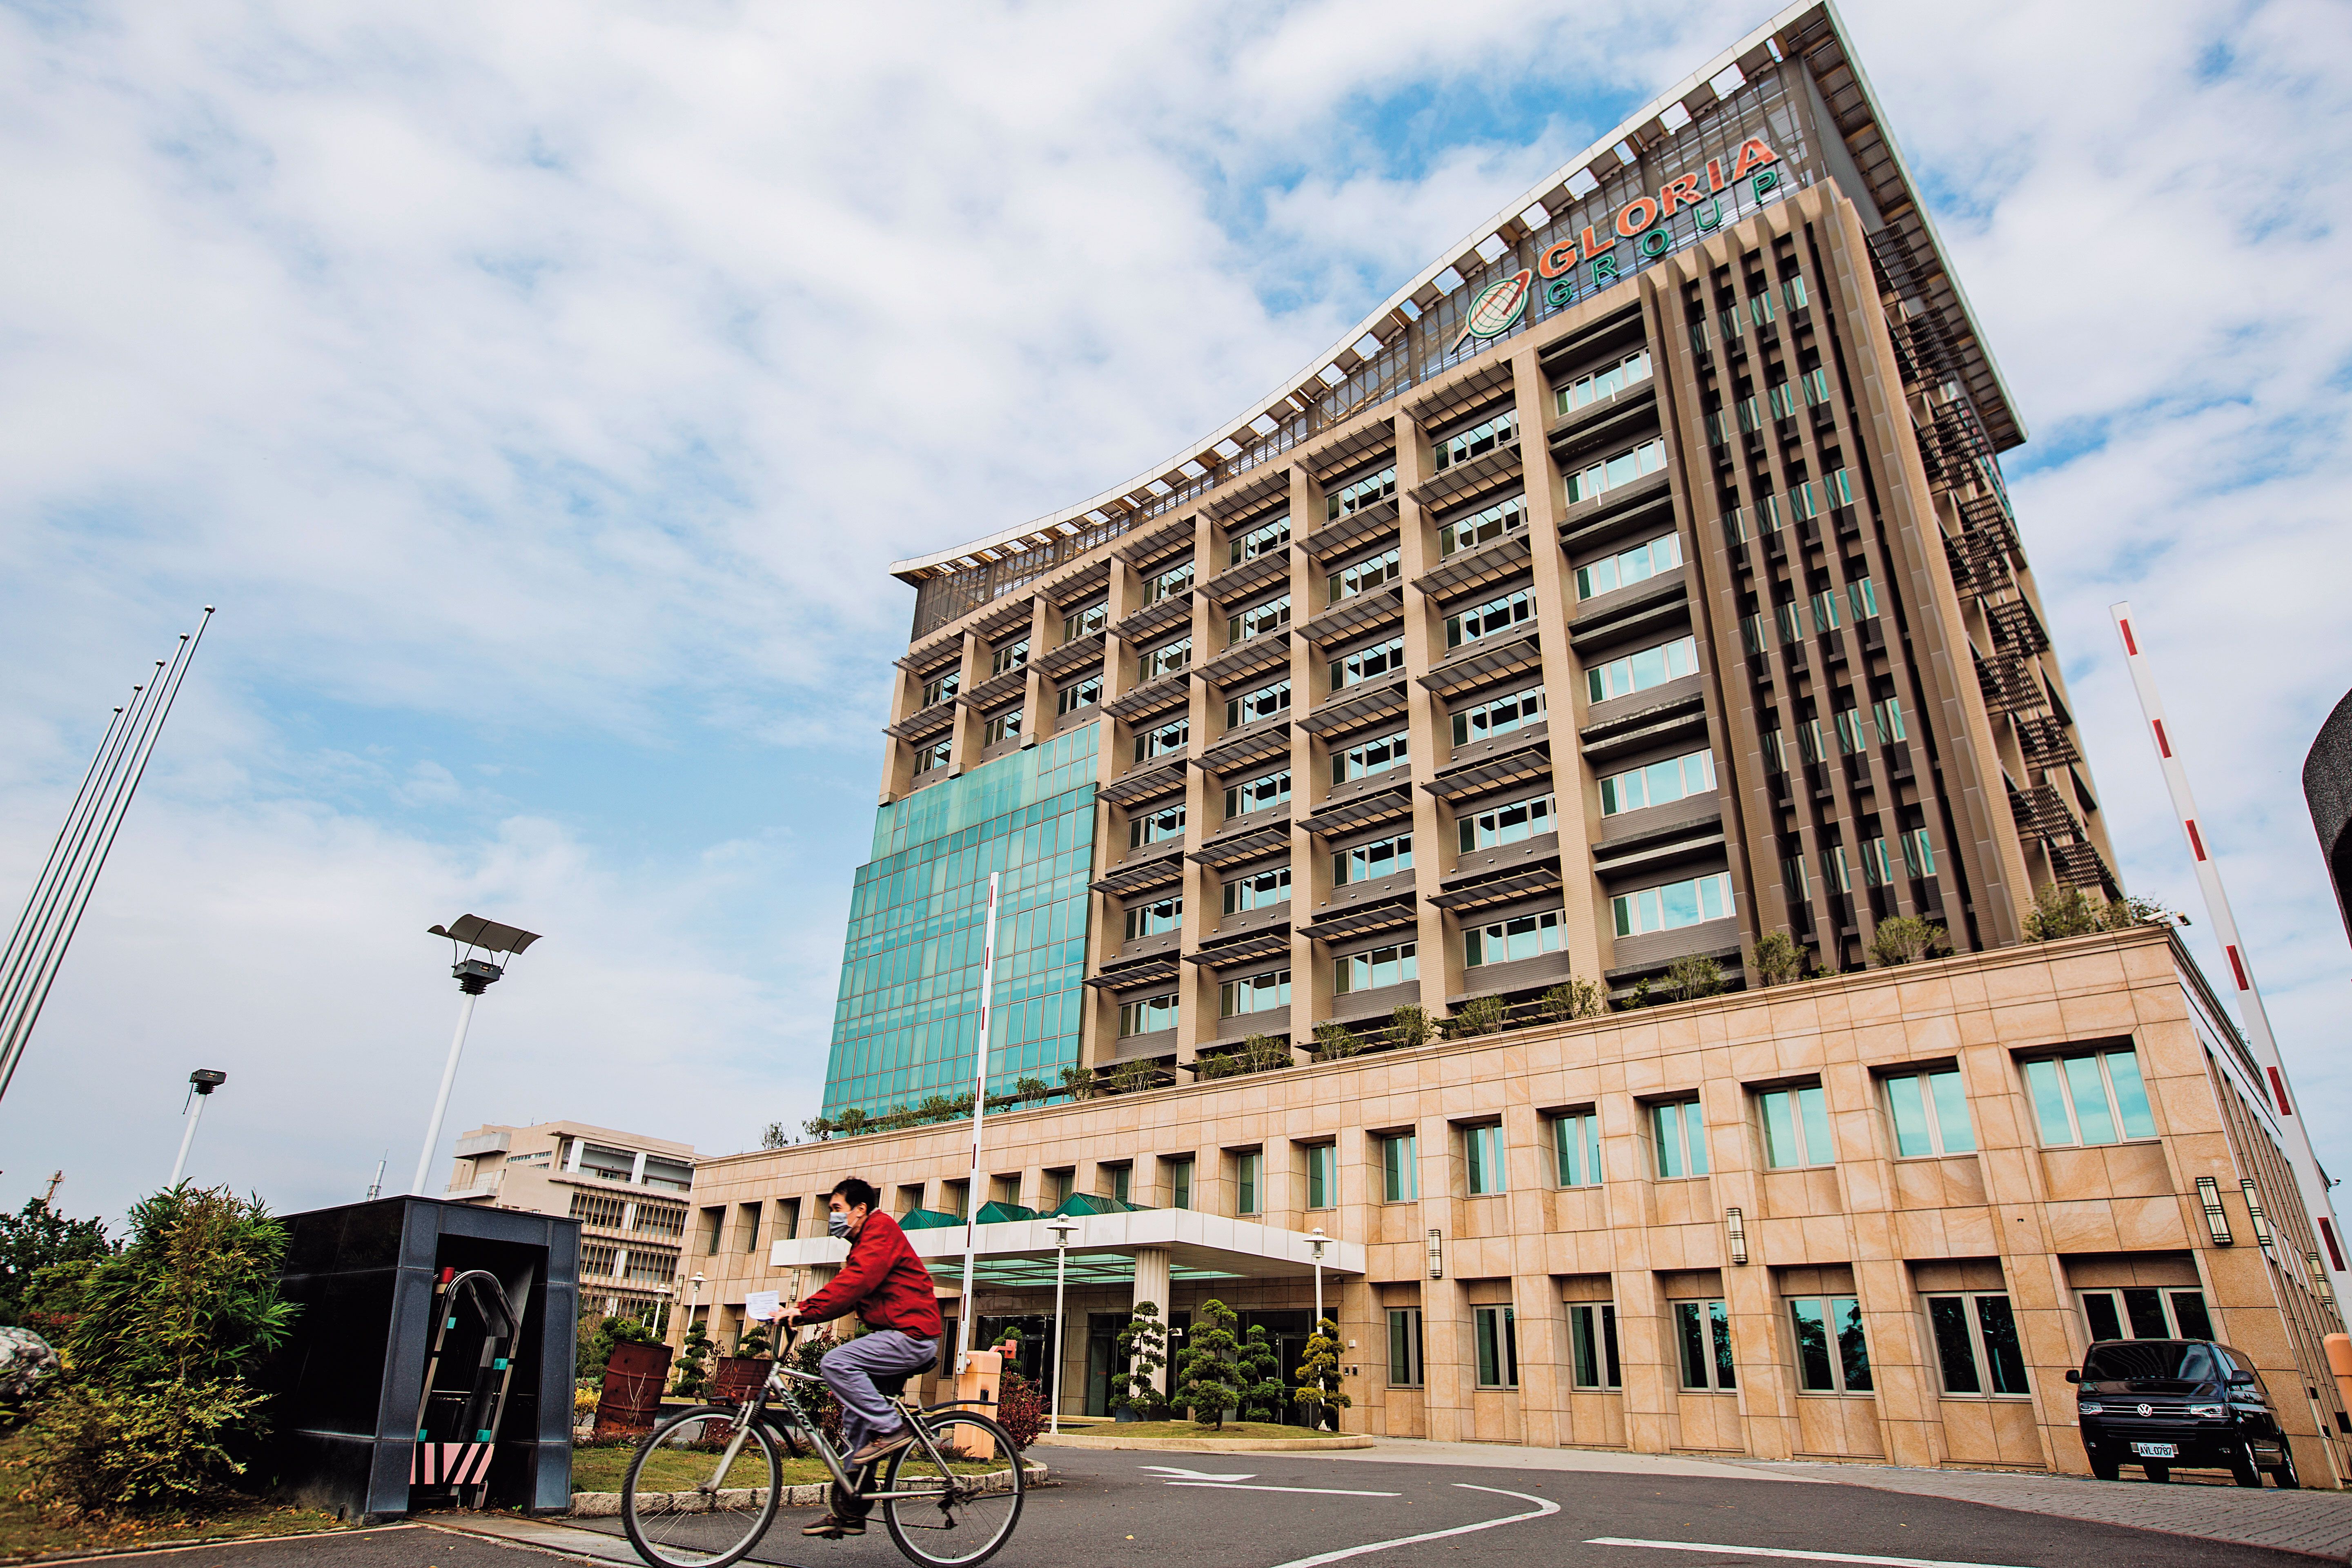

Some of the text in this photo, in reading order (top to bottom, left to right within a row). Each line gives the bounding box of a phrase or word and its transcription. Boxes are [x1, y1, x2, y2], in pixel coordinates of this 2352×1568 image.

[1538, 136, 1781, 279] GLORIA
[1546, 171, 1777, 307] GROUP
[780, 1388, 816, 1433] GIANT
[2140, 1446, 2171, 1455] AVL-0787
